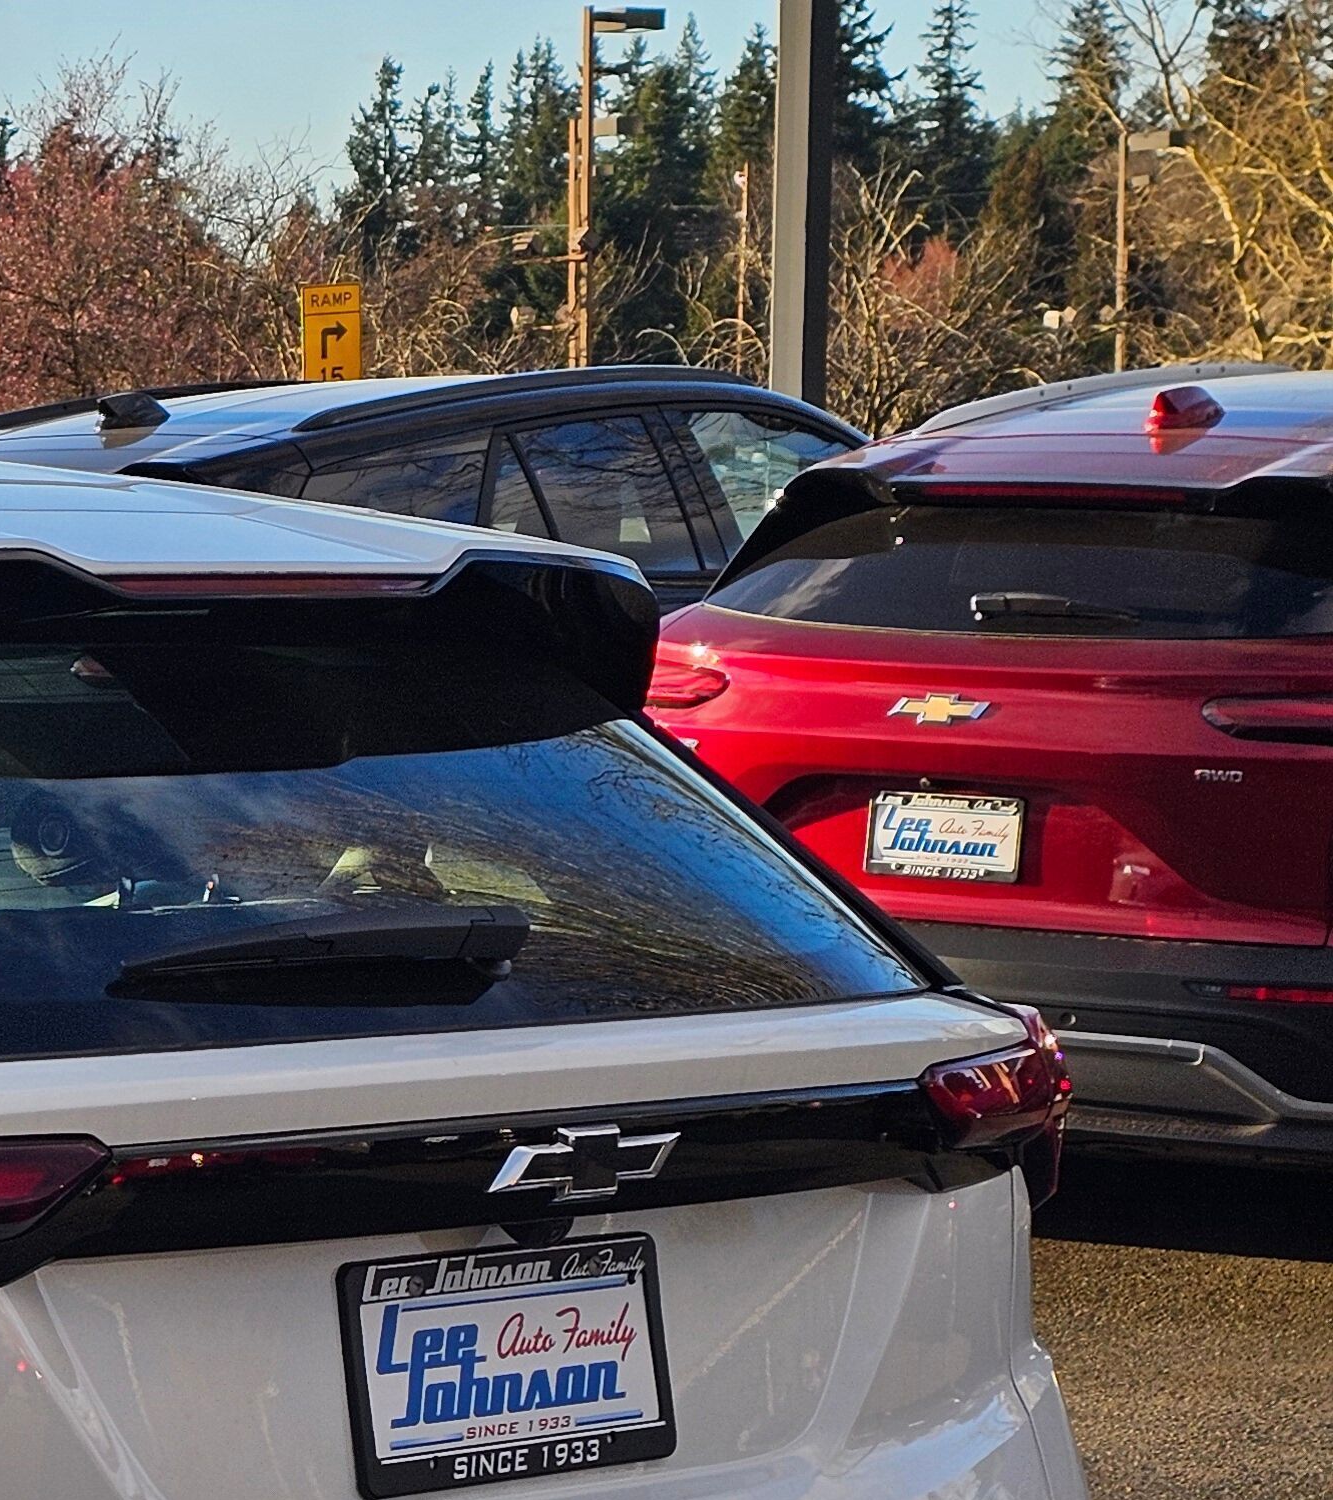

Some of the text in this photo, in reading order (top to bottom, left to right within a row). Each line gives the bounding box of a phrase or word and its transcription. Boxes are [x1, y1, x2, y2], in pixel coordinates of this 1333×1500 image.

[310, 291, 353, 308] RAMP
[321, 366, 344, 381] 15
[883, 807, 933, 832] Lee
[971, 820, 1010, 843] Family
[883, 829, 999, 857] Johnson
[902, 864, 978, 880] SINCE 1933
[425, 1255, 553, 1296] Johnson
[561, 1252, 594, 1280] Aut
[598, 1246, 646, 1281] Family
[376, 1304, 486, 1376] Lee
[496, 1302, 638, 1362] Auto Family
[391, 1350, 626, 1428] Johnson
[465, 1415, 571, 1440] SINCE 1933
[453, 1439, 600, 1480] SINCE 1933
